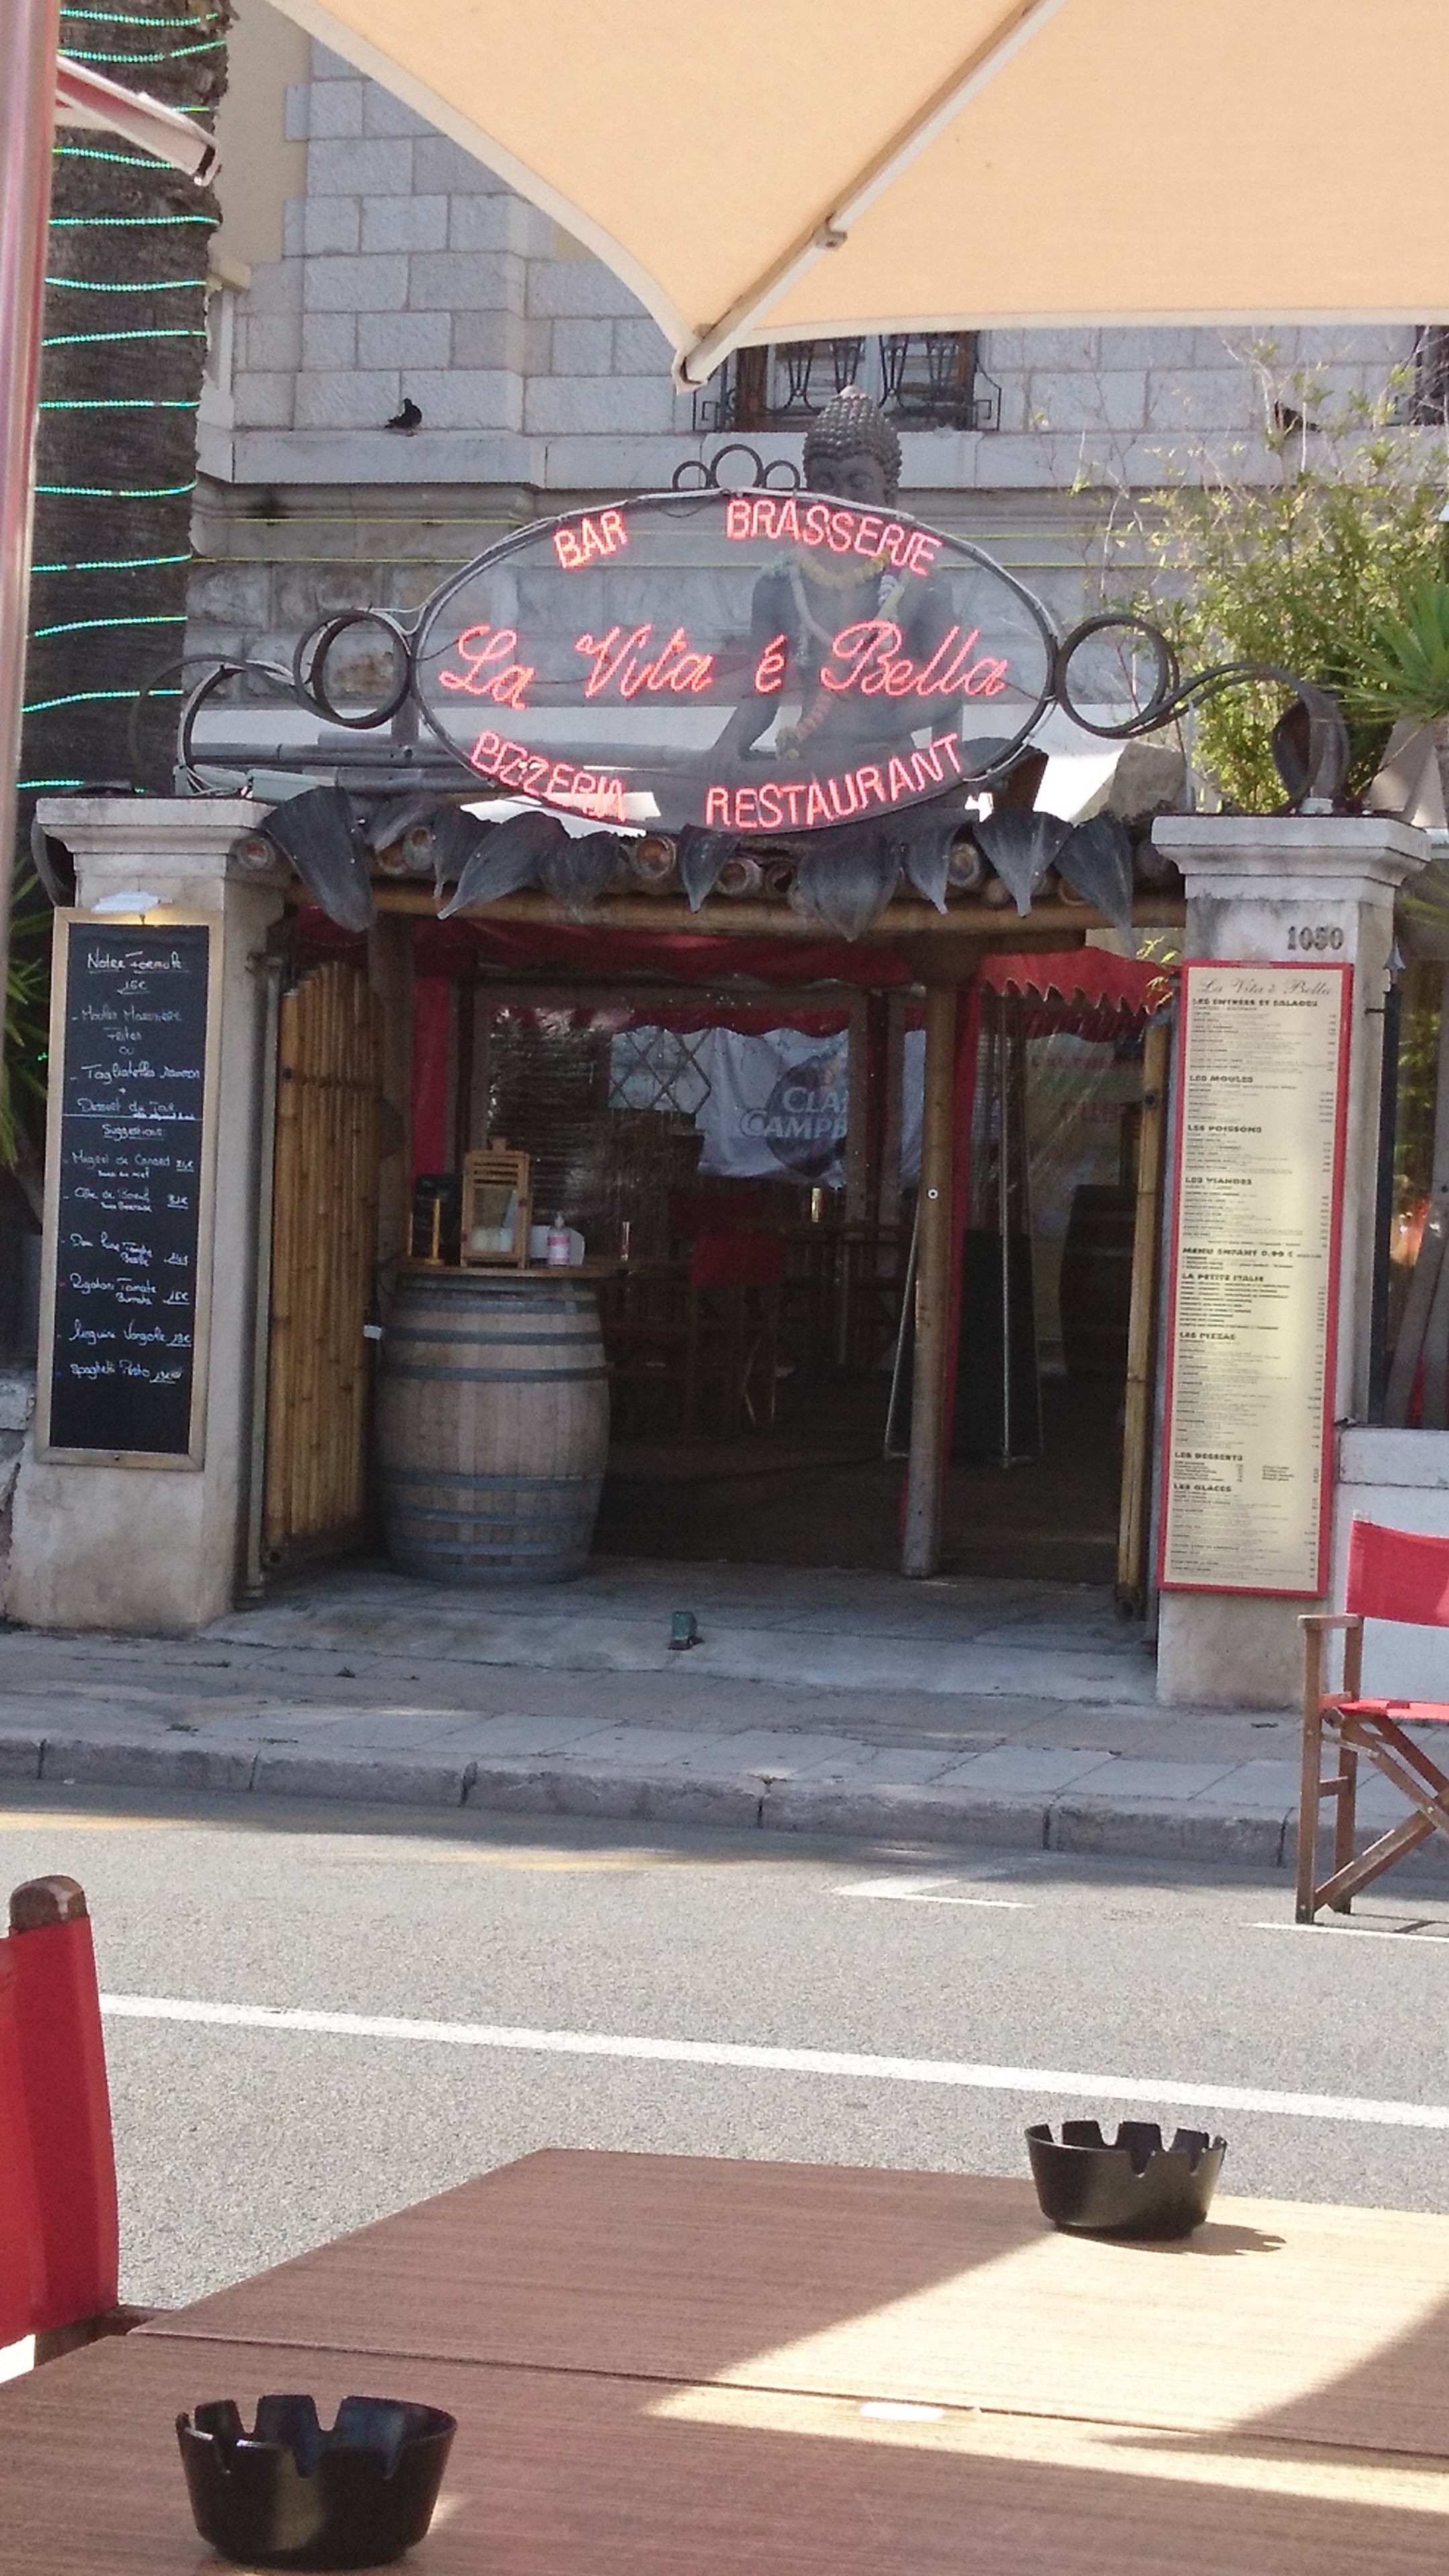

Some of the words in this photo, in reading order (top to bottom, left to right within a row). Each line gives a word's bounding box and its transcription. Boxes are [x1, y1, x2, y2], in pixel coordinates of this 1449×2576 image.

[554, 510, 628, 569] BAR
[725, 499, 943, 576] BRASSERIE
[439, 624, 535, 710] La
[575, 623, 714, 698] Vita
[820, 620, 1008, 696] Bella
[706, 733, 961, 828] RESTAURANT
[1287, 926, 1344, 951] 1050
[1232, 977, 1263, 994] Vita
[1283, 978, 1332, 995] Bella
